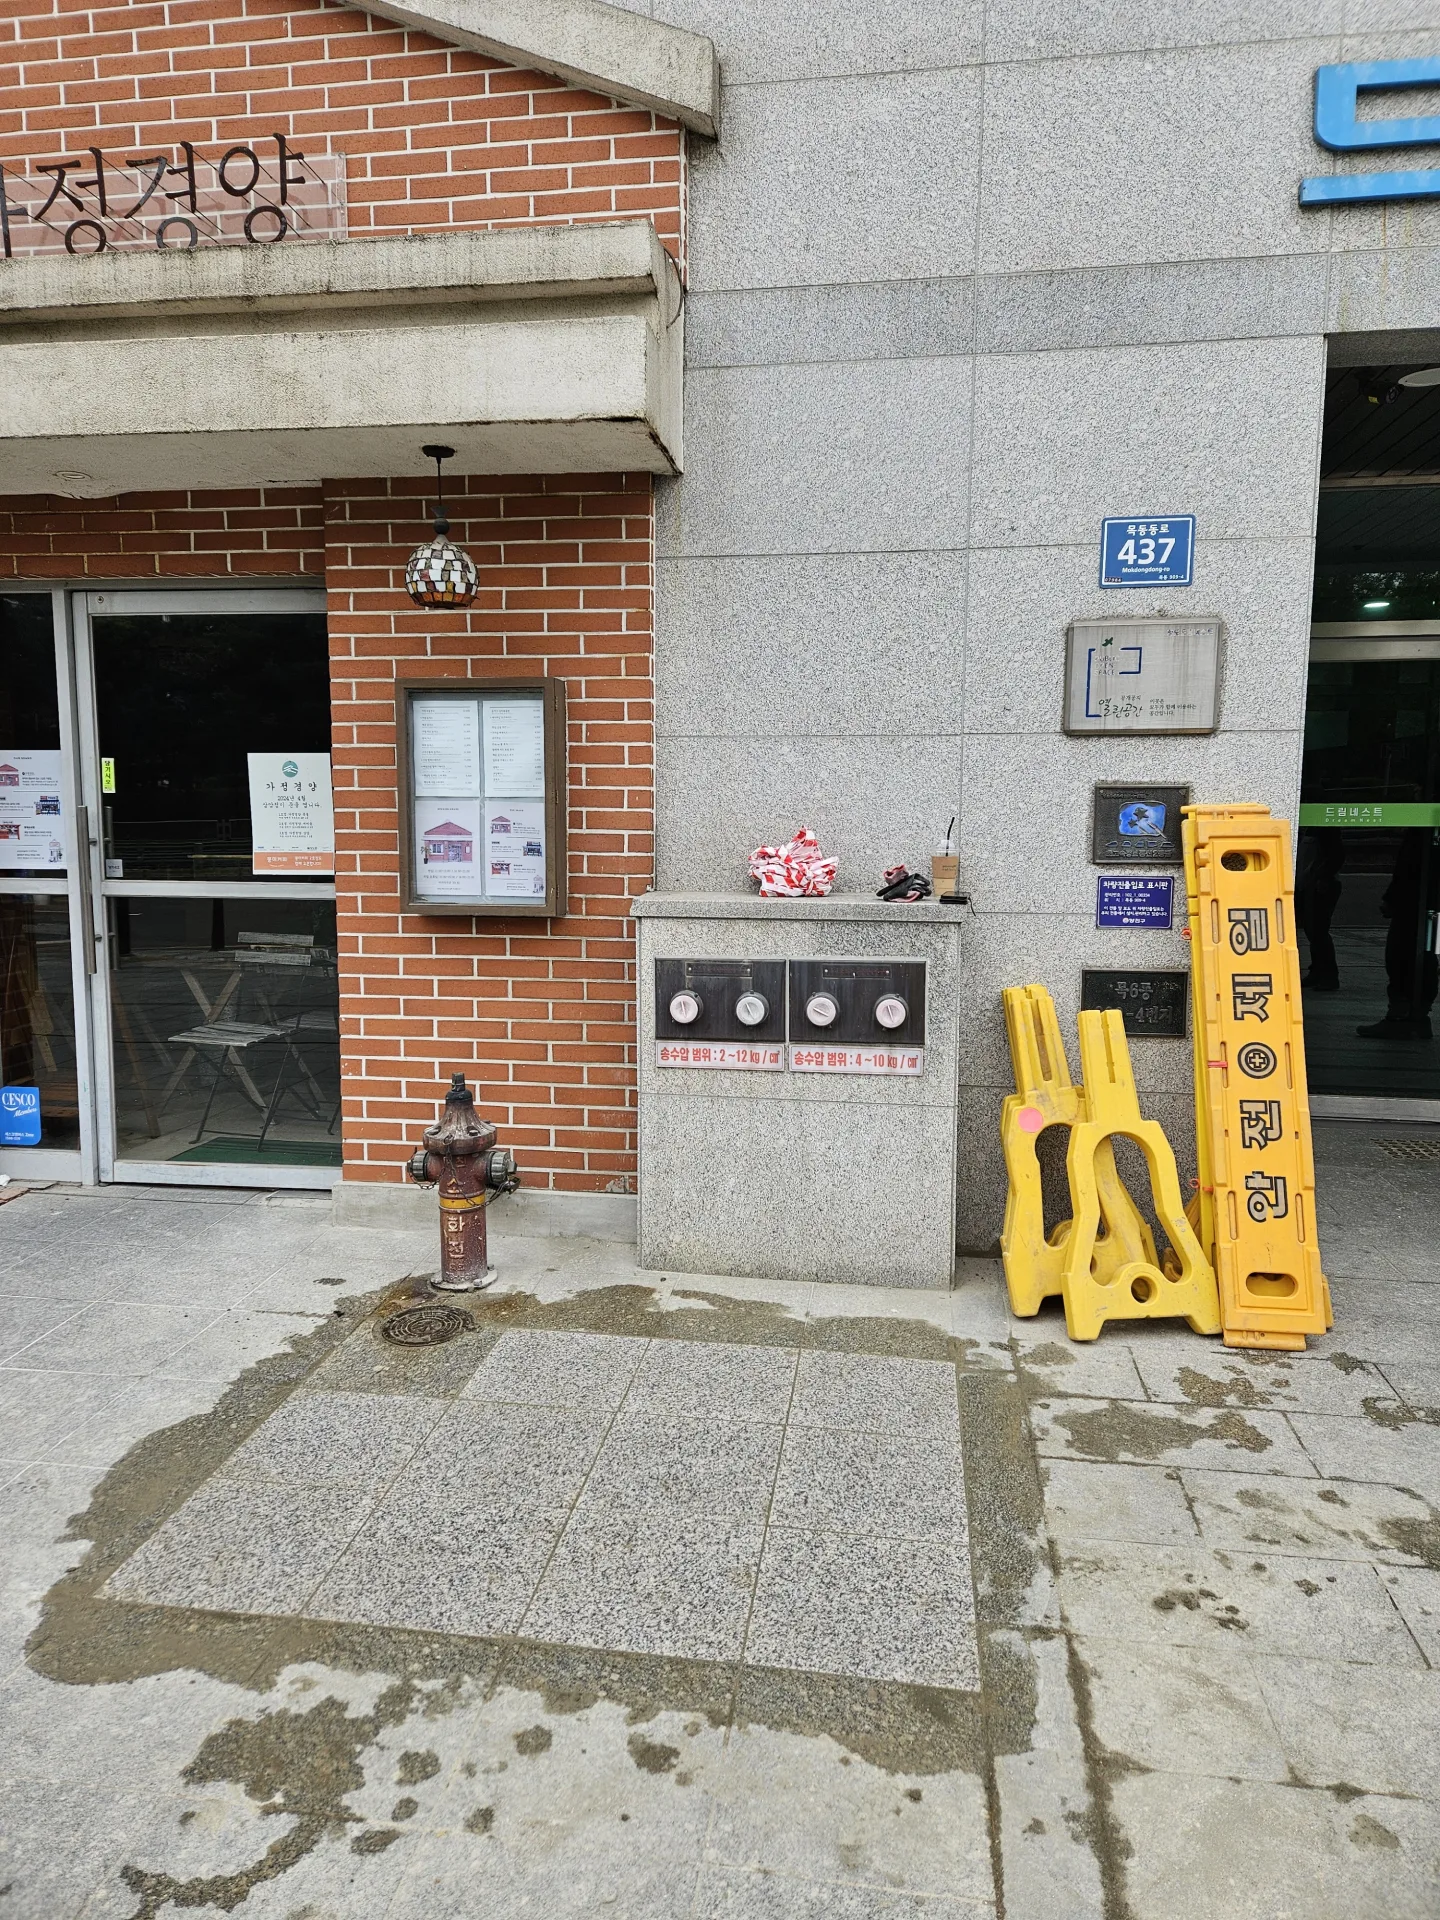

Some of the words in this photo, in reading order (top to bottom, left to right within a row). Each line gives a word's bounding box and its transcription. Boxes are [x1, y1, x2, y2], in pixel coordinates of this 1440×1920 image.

[1126, 523, 1170, 536] 목동동로
[1117, 537, 1176, 565] 437
[1121, 566, 1170, 574] Mokdongdong-ro
[1325, 807, 1383, 817] 드림네스트
[1103, 880, 1145, 890] 차량진출입로
[1146, 881, 1168, 890] 표시판
[1114, 981, 1154, 1000] 목6동
[660, 1046, 689, 1061] 송수압
[691, 1047, 712, 1062] 범위
[719, 1049, 726, 1062] 2
[749, 1050, 760, 1064] kg
[794, 1050, 825, 1066] 송수압
[827, 1051, 847, 1067] 범위
[855, 1053, 862, 1067] 4
[887, 1054, 898, 1069] kg
[2, 1092, 36, 1107] CESCO
